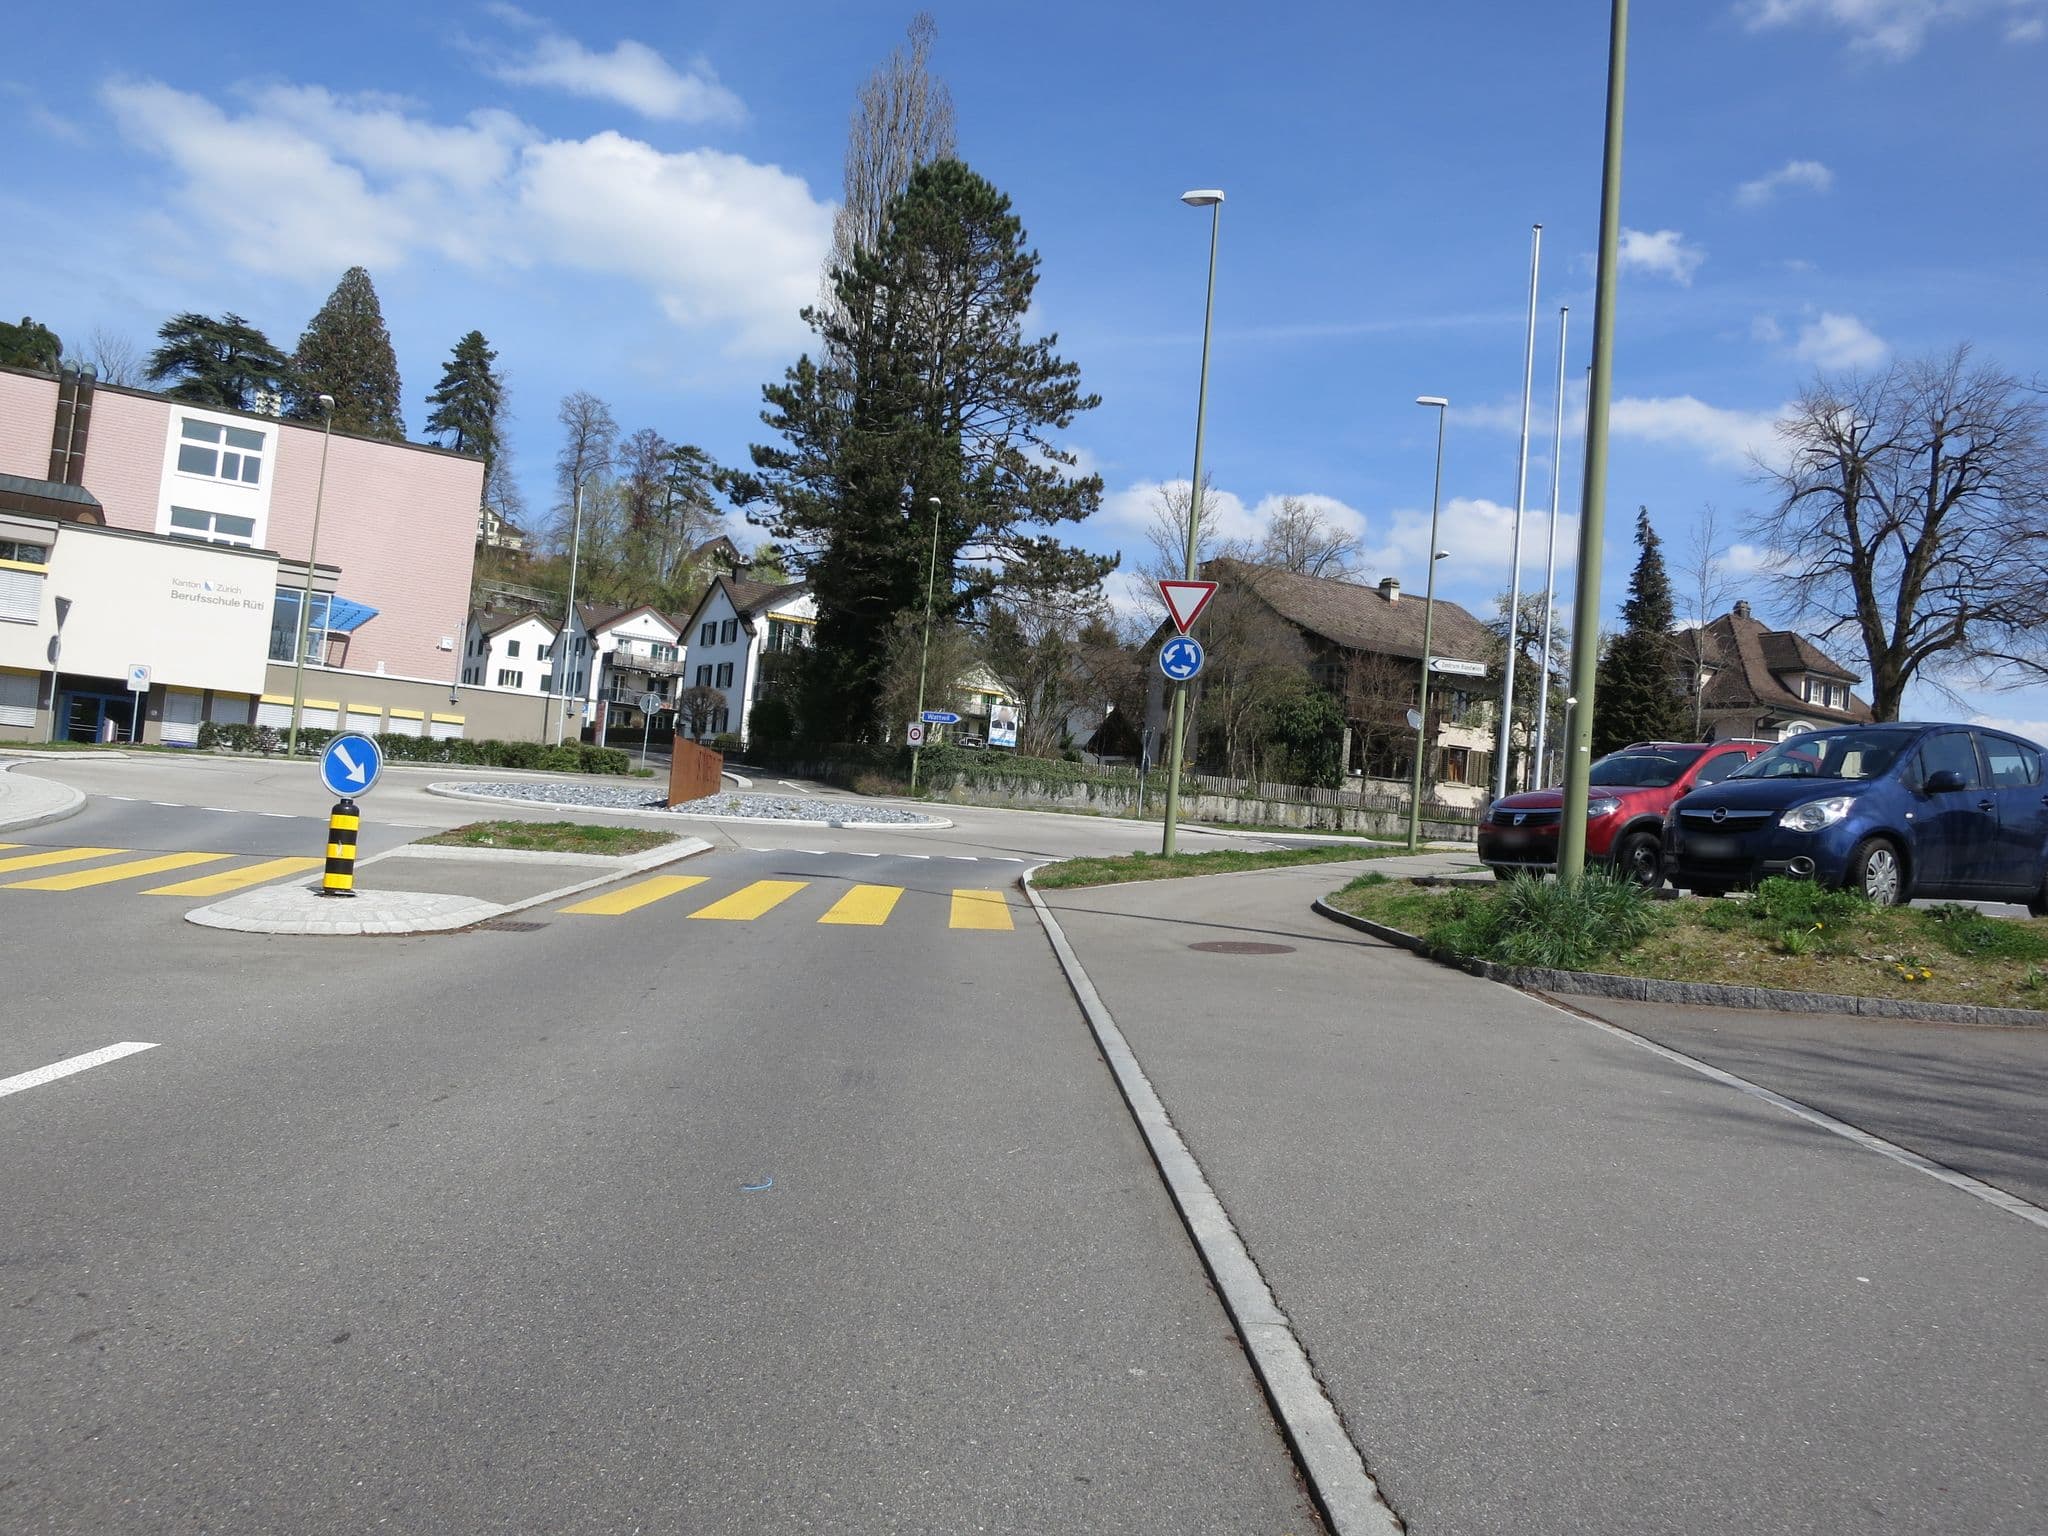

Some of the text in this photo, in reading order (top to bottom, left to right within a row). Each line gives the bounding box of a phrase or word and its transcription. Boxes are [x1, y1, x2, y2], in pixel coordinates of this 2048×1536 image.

[172, 577, 202, 590] Kanton
[170, 589, 265, 611] Berufsschule Rüti
[927, 713, 951, 721] Wattwil
